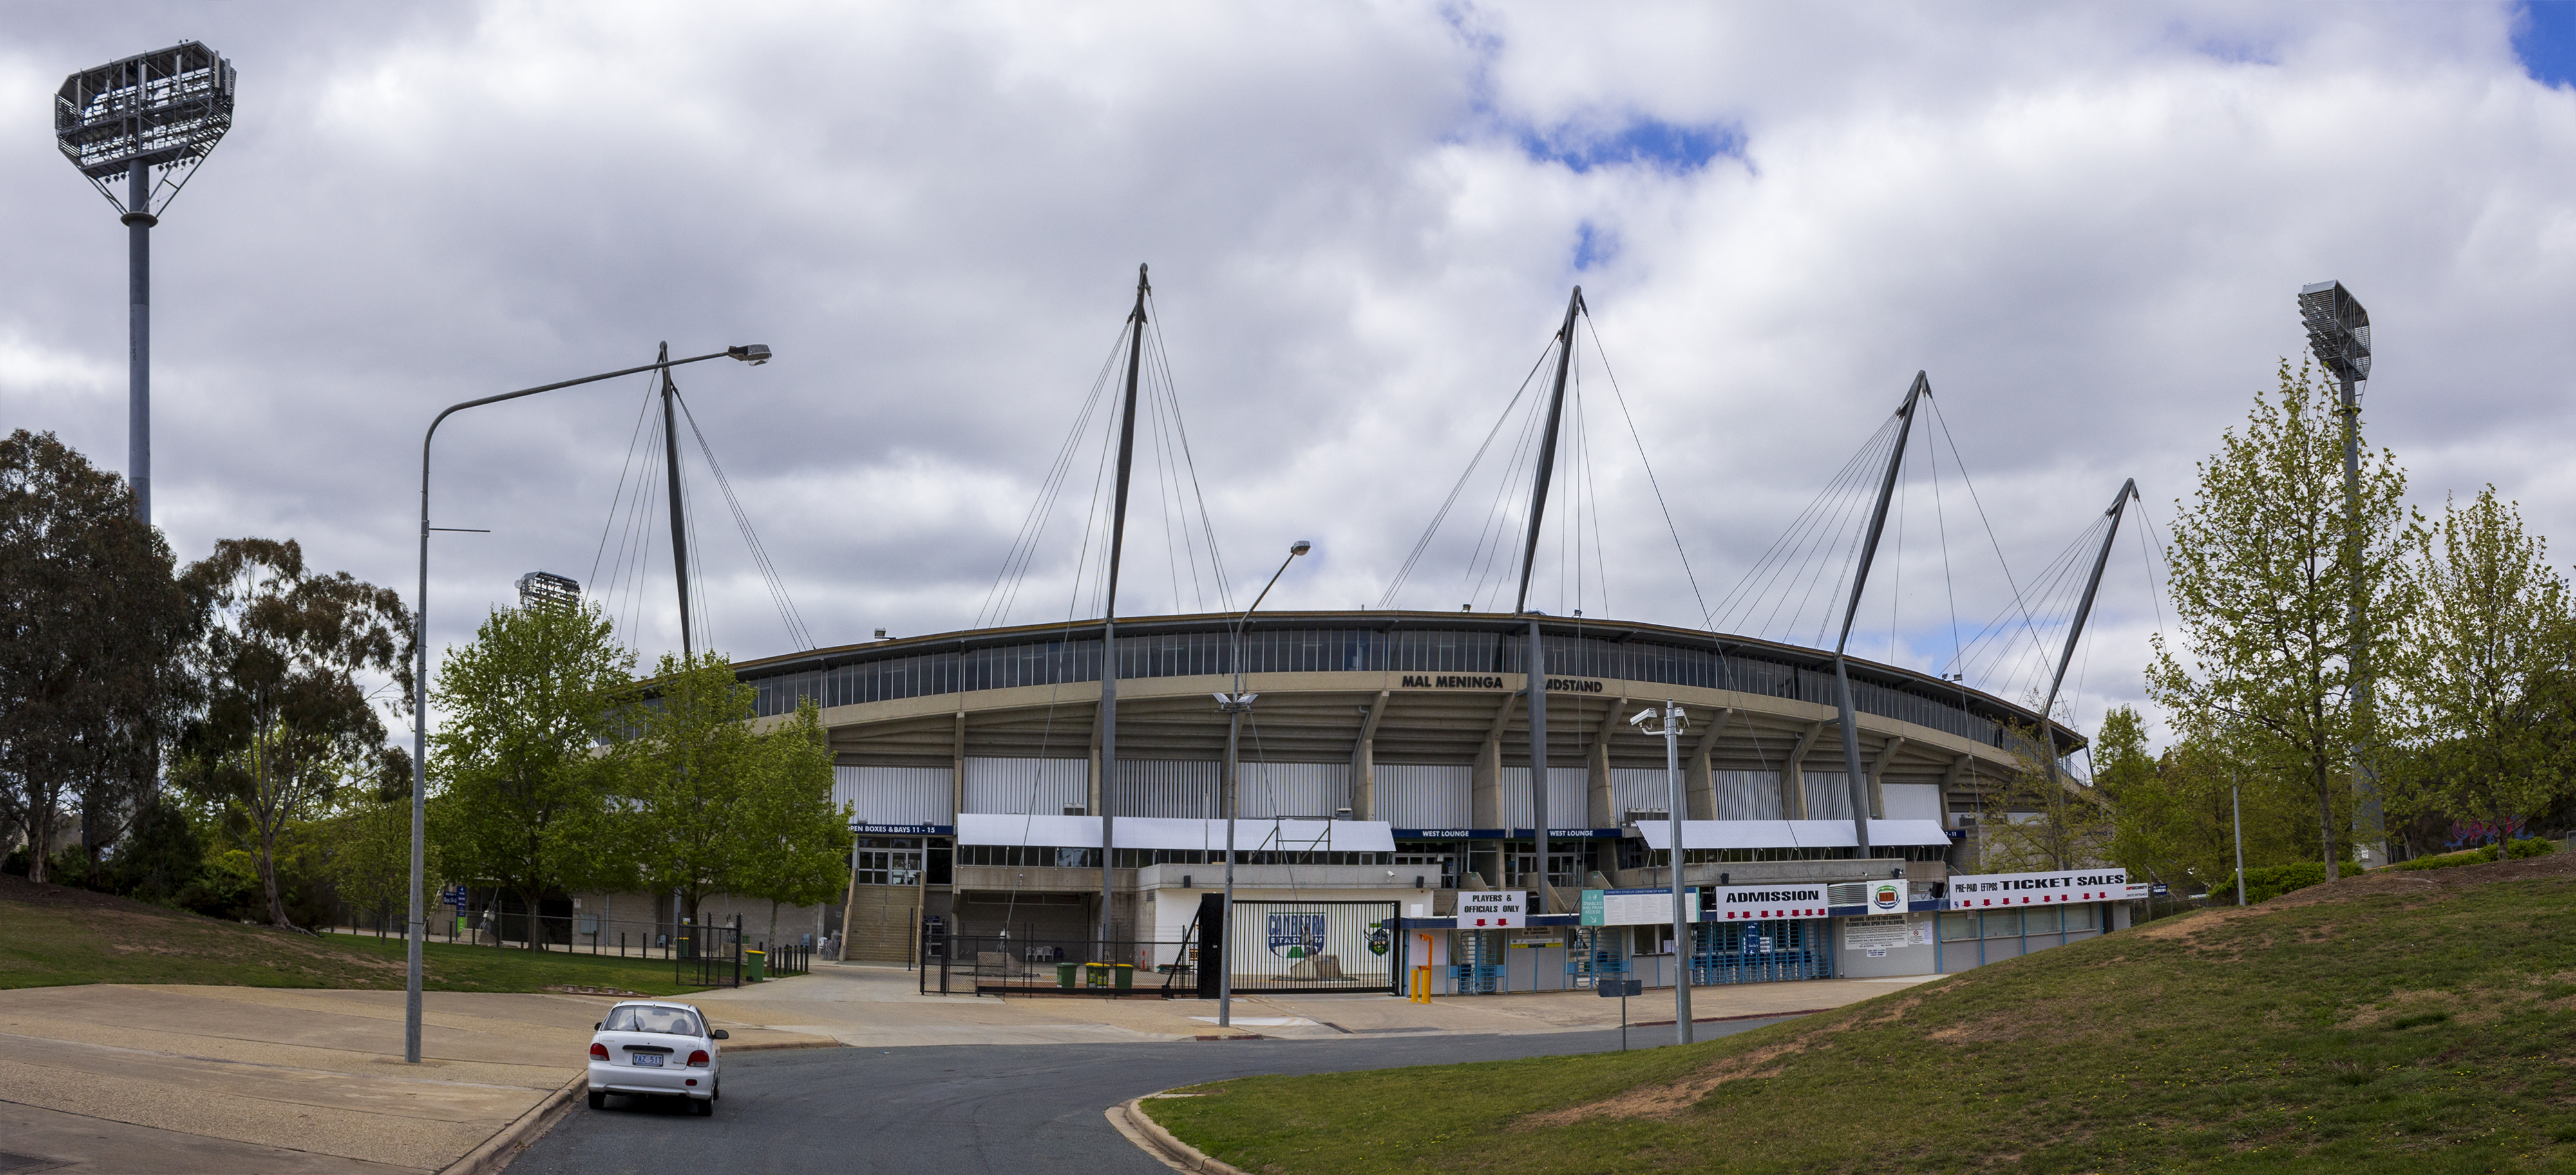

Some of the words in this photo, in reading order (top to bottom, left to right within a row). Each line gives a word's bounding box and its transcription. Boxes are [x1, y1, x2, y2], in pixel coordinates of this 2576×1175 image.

[1401, 675, 1432, 688] MAL
[1435, 675, 1504, 688] MENINGA
[1955, 883, 1977, 892] PRE-PAID
[1981, 882, 1998, 892] EFTPOS
[2000, 877, 2073, 890] TICKET
[2077, 874, 2125, 886] SALES
[1726, 890, 1819, 903] ADMISSION
